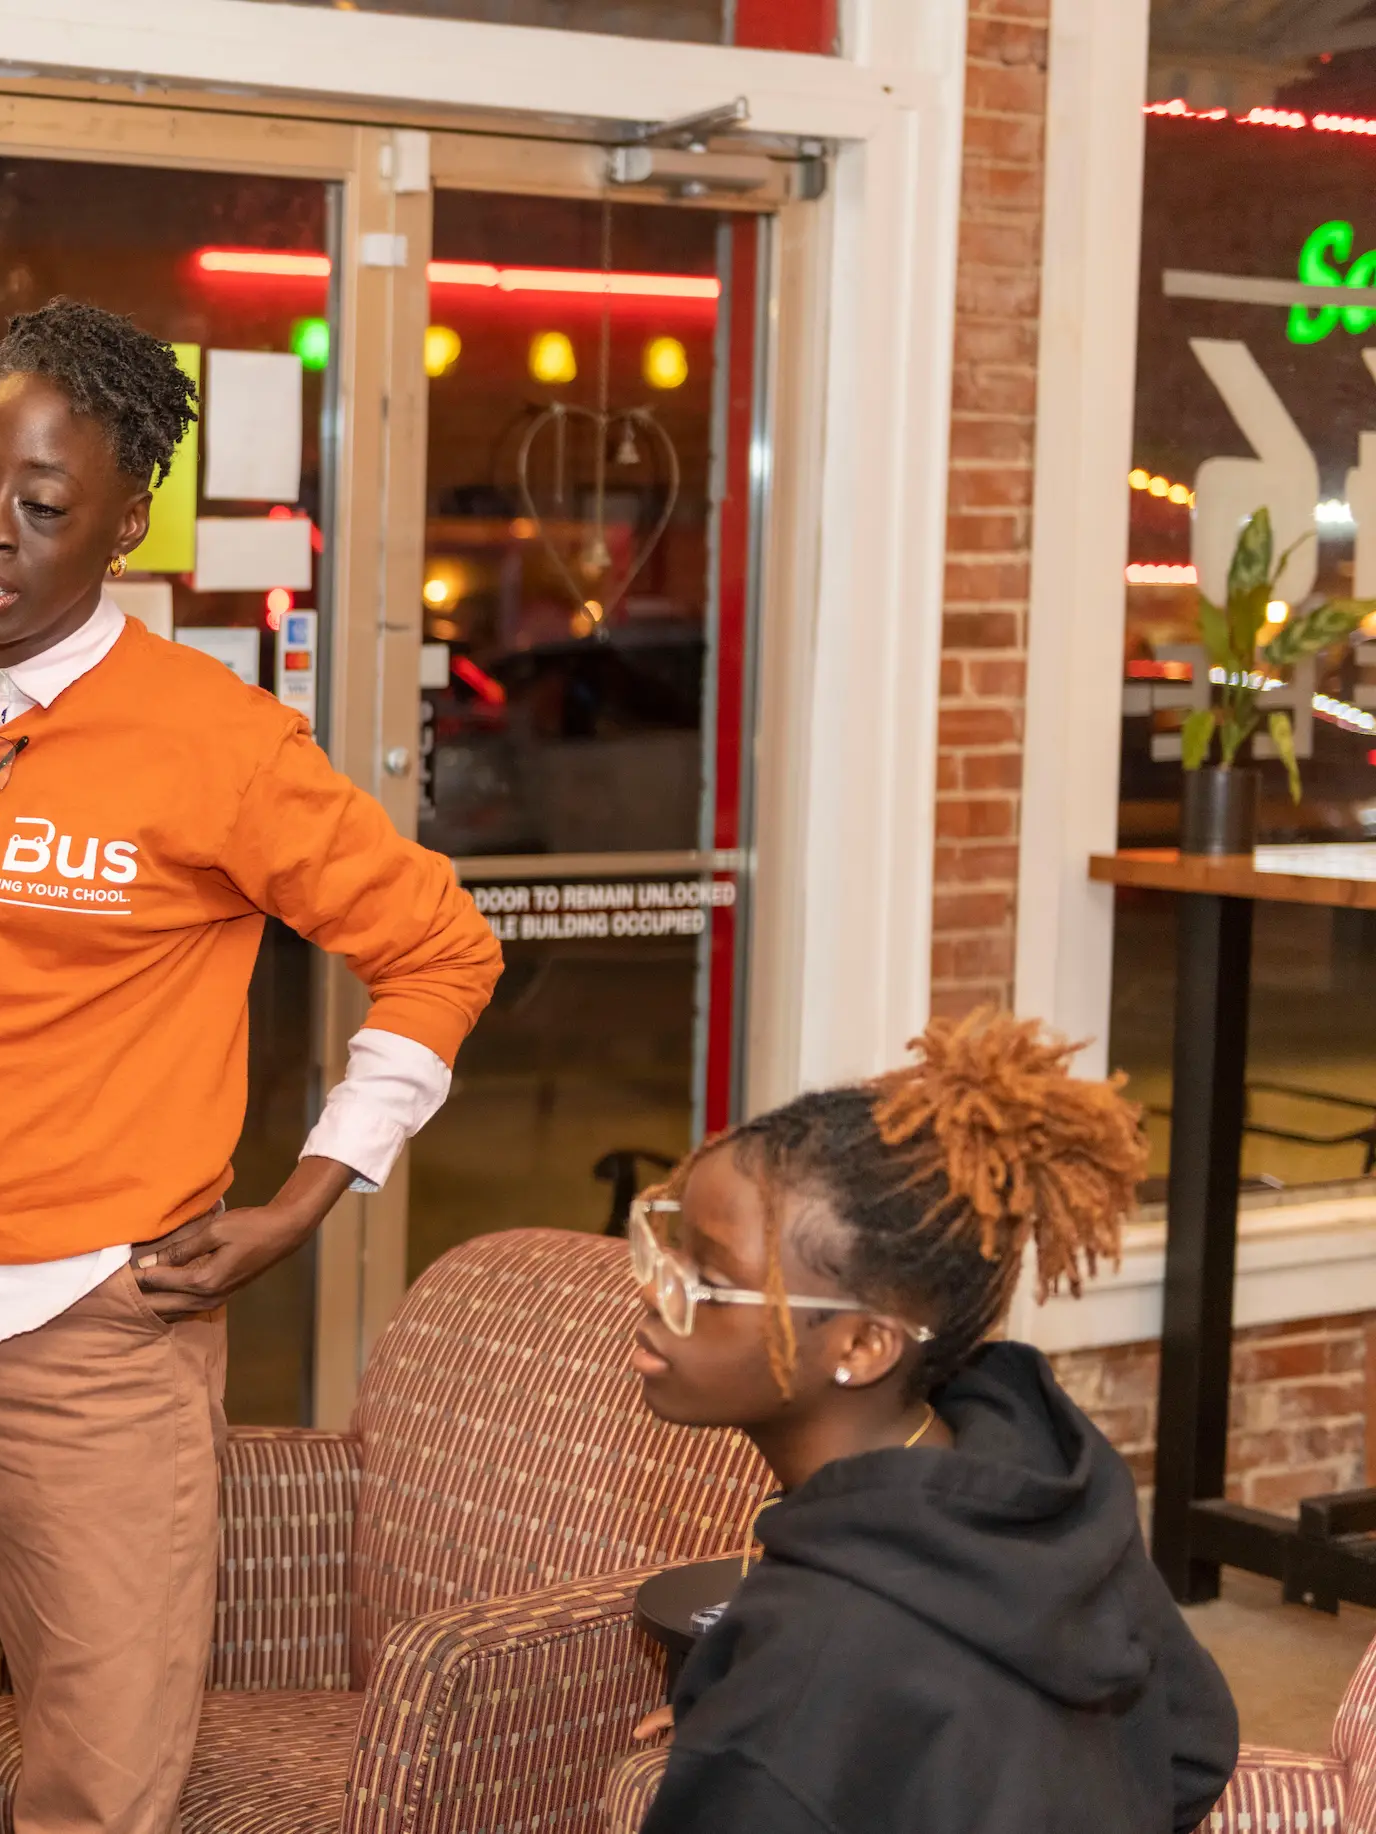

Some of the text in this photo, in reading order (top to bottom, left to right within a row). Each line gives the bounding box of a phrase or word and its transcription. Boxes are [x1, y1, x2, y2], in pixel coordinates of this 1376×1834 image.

[2, 817, 139, 883] Bus
[27, 882, 68, 898] YOUR
[474, 881, 736, 914] DOOR TO REMAIN UNLOCKED
[522, 912, 609, 939] BUILDING
[612, 909, 706, 936] OCCUPIED
